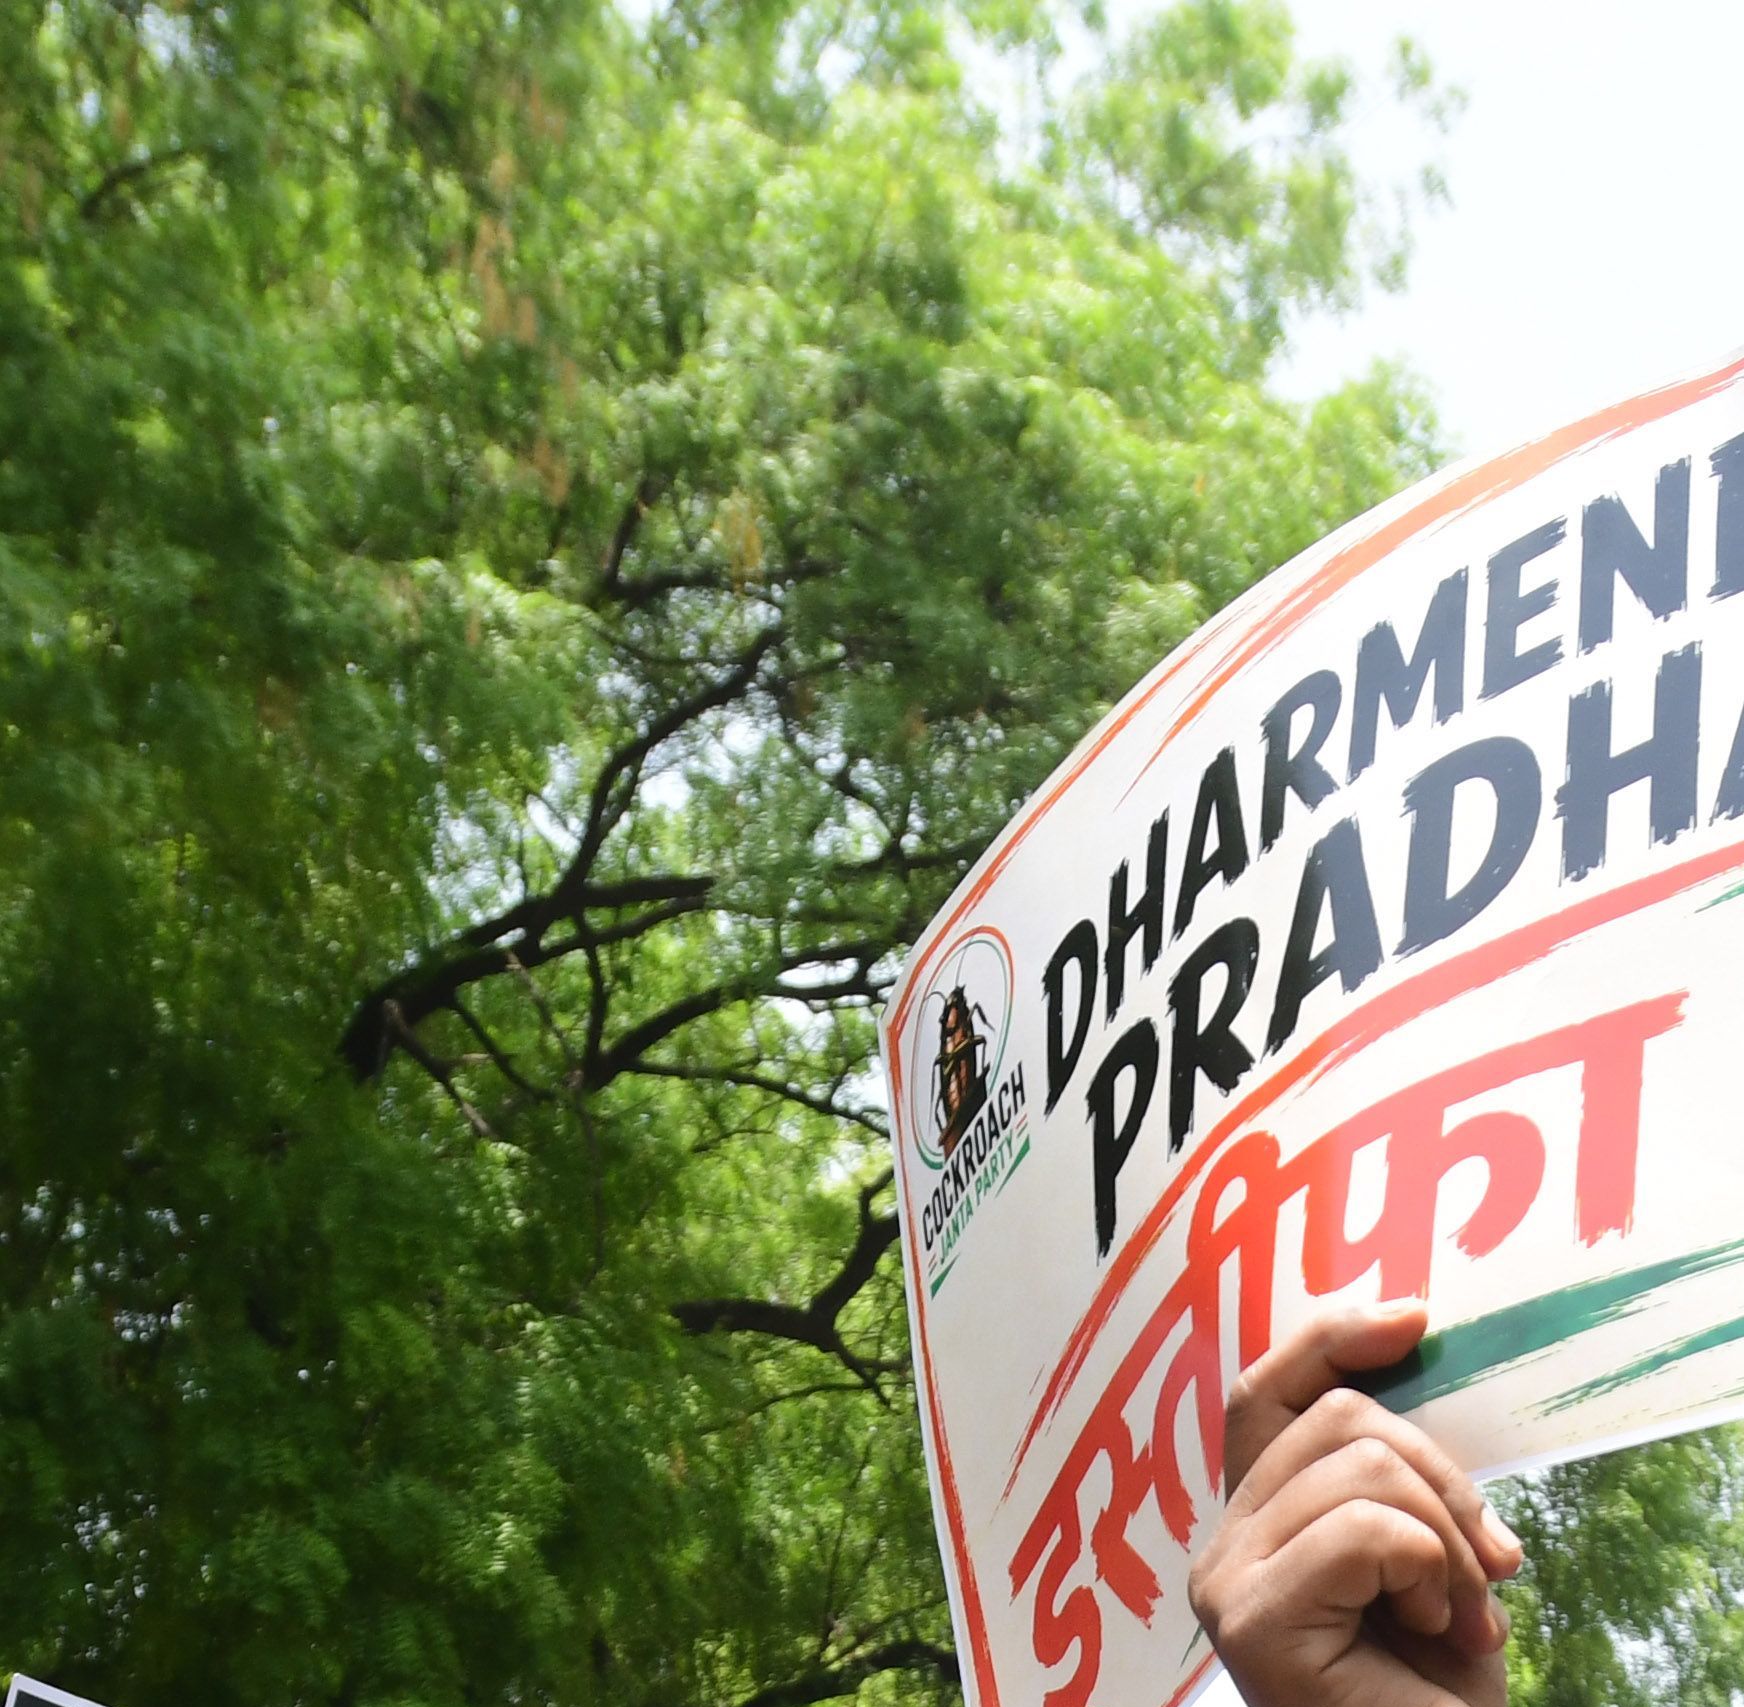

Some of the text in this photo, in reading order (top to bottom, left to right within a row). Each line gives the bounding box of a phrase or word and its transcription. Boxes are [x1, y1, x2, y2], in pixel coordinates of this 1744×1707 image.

[922, 1060, 1026, 1252] COCKROACH
[940, 1128, 1015, 1265] JANTA PARTY
